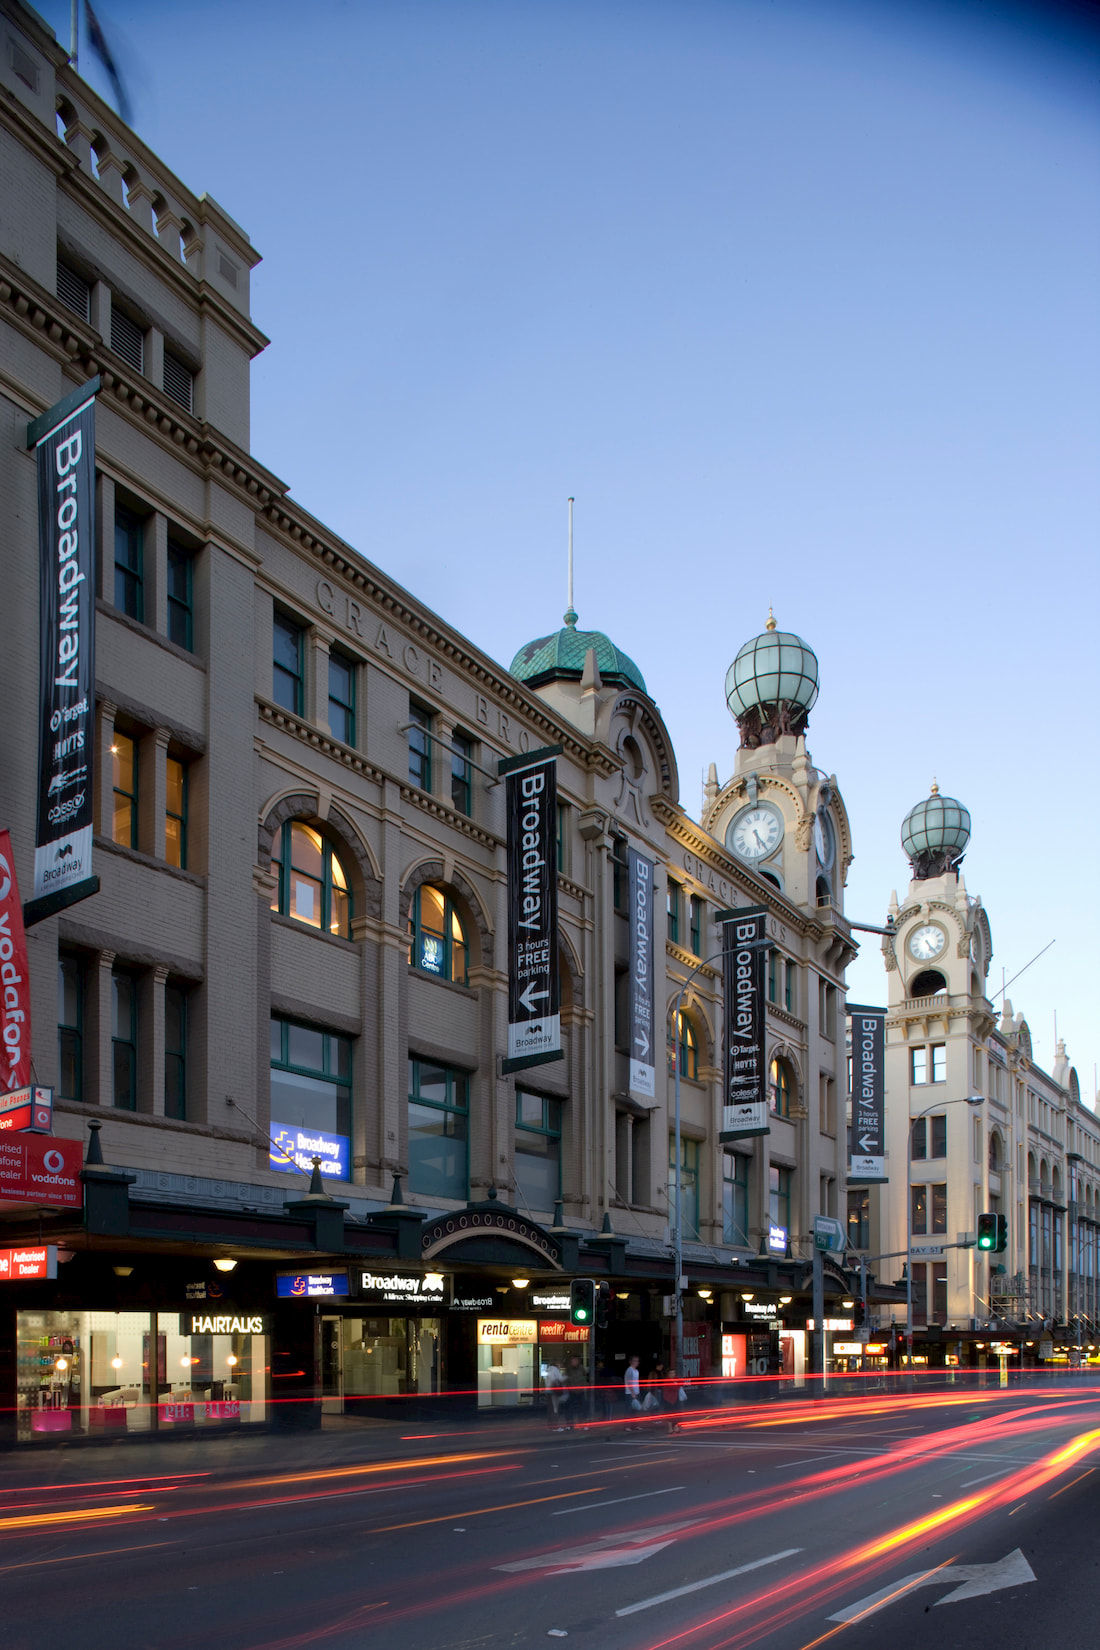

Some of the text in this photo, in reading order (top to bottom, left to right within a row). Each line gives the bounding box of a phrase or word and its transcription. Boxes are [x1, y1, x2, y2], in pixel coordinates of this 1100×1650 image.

[55, 430, 86, 687] Broadway
[316, 579, 545, 753] GRACE BRO
[54, 731, 85, 760] HOYTS
[517, 771, 546, 931] Broadway
[43, 857, 83, 883] Broadway
[683, 852, 738, 908] GRACE
[635, 858, 649, 993] Broadway
[518, 938, 549, 953] 3 hours
[517, 949, 550, 968] FREE
[518, 964, 550, 980] parking
[634, 1002, 651, 1020] FREE
[515, 1035, 552, 1048] Broadway
[735, 1059, 757, 1070] HOYTS
[858, 1018, 878, 1110] Broadway
[9, 1092, 30, 1105] Phones
[730, 1116, 760, 1124] Broadway
[858, 1118, 879, 1126] FREE
[297, 1132, 340, 1160] Broadway
[31, 1173, 76, 1187] vodafone
[1, 1186, 26, 1196] business
[13, 1250, 46, 1263] Authorised
[19, 1263, 40, 1275] Dealer
[361, 1272, 420, 1294] Broadway
[405, 1294, 428, 1302] Shopping
[533, 1295, 571, 1306] Broadway
[192, 1315, 263, 1333] HAIRTALKS
[564, 1330, 579, 1341] rent
